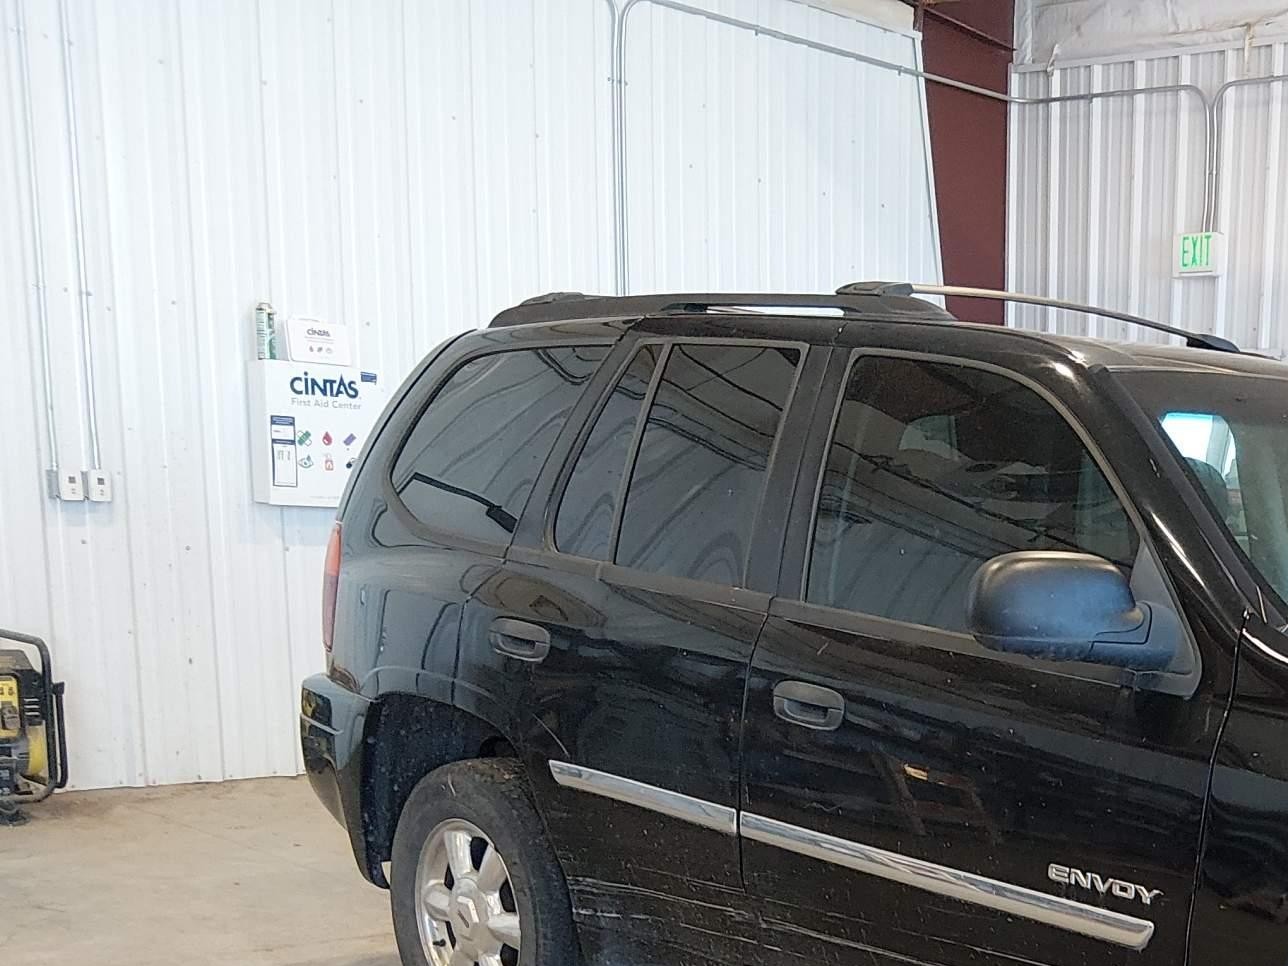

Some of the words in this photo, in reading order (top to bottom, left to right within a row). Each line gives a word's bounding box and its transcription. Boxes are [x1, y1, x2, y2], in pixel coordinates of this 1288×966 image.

[1182, 235, 1212, 267] EXIT
[290, 371, 359, 399] CINTAS
[291, 397, 312, 406] First
[314, 399, 329, 408] Aid
[332, 400, 361, 410] Center
[1048, 863, 1164, 905] ENVOY
